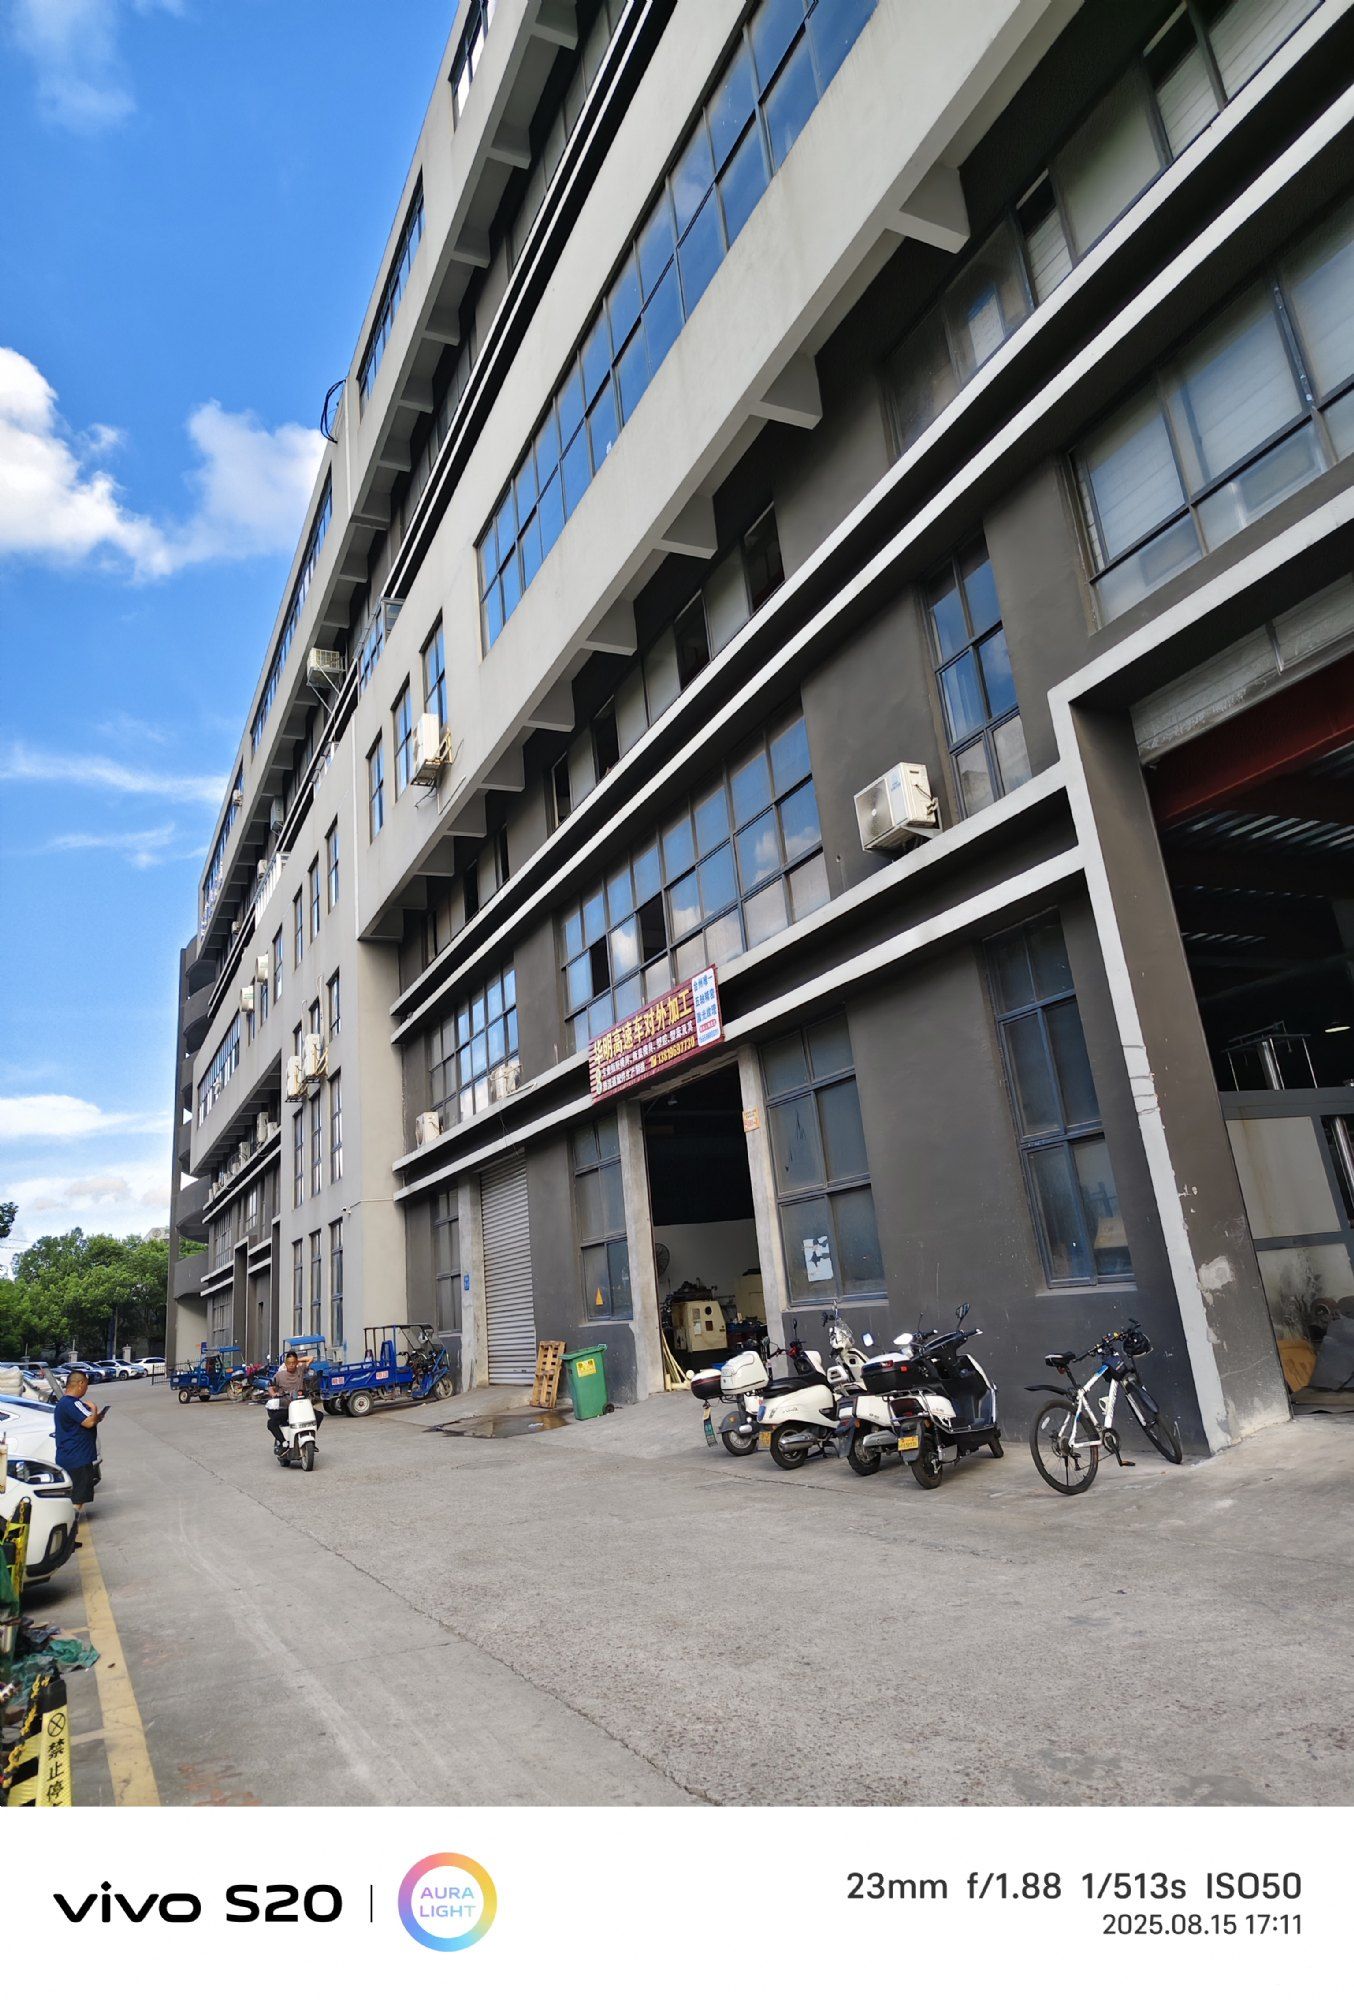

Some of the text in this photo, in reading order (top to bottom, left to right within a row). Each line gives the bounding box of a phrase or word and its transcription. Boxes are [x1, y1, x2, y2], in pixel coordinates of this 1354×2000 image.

[593, 989, 692, 1065] 华明高速车对外加工
[46, 1738, 66, 1806] 禁止停
